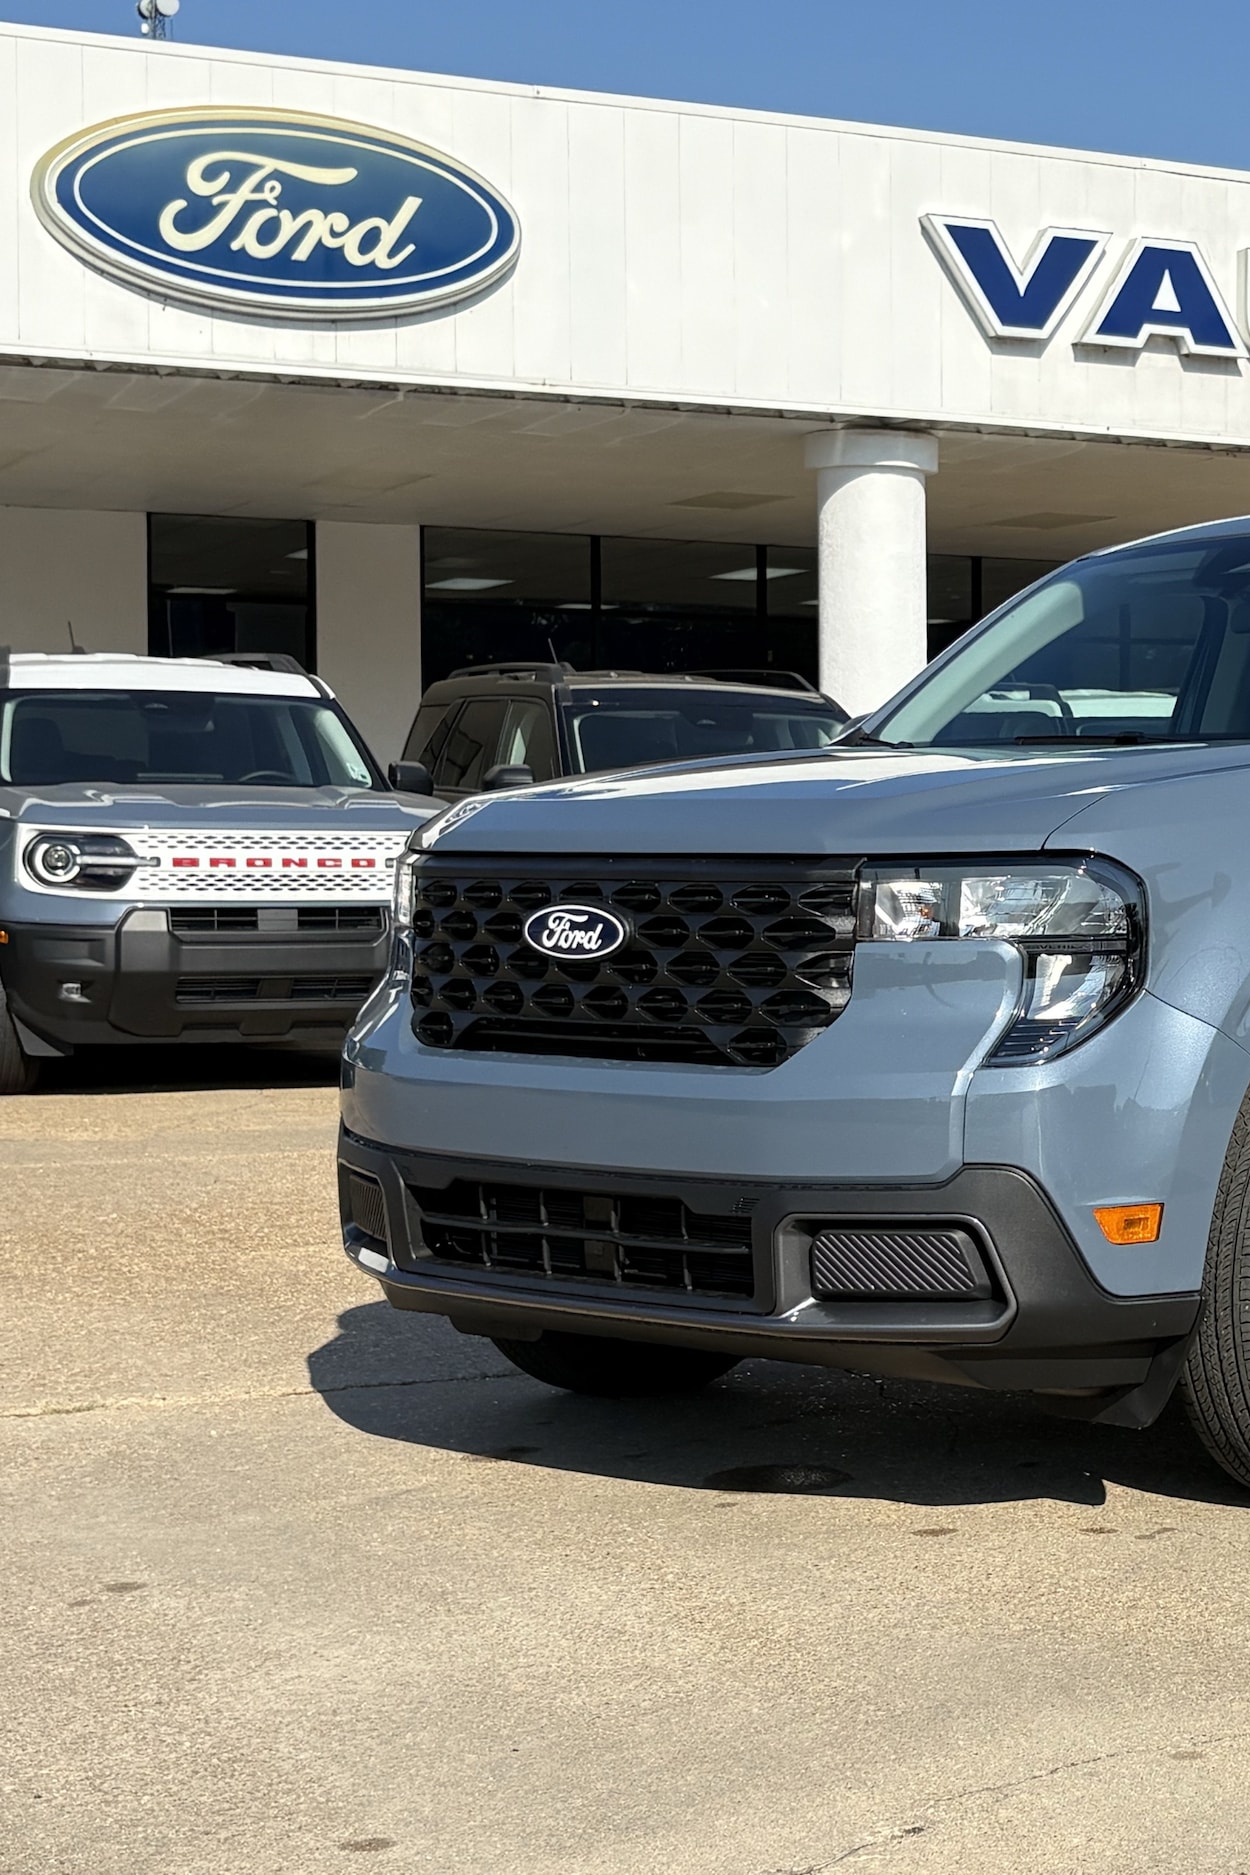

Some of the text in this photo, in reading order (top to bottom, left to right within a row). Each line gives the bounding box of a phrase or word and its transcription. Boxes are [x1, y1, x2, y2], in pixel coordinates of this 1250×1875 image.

[158, 151, 423, 269] Ford
[172, 857, 376, 868] BRONCO
[542, 911, 604, 950] Ford
